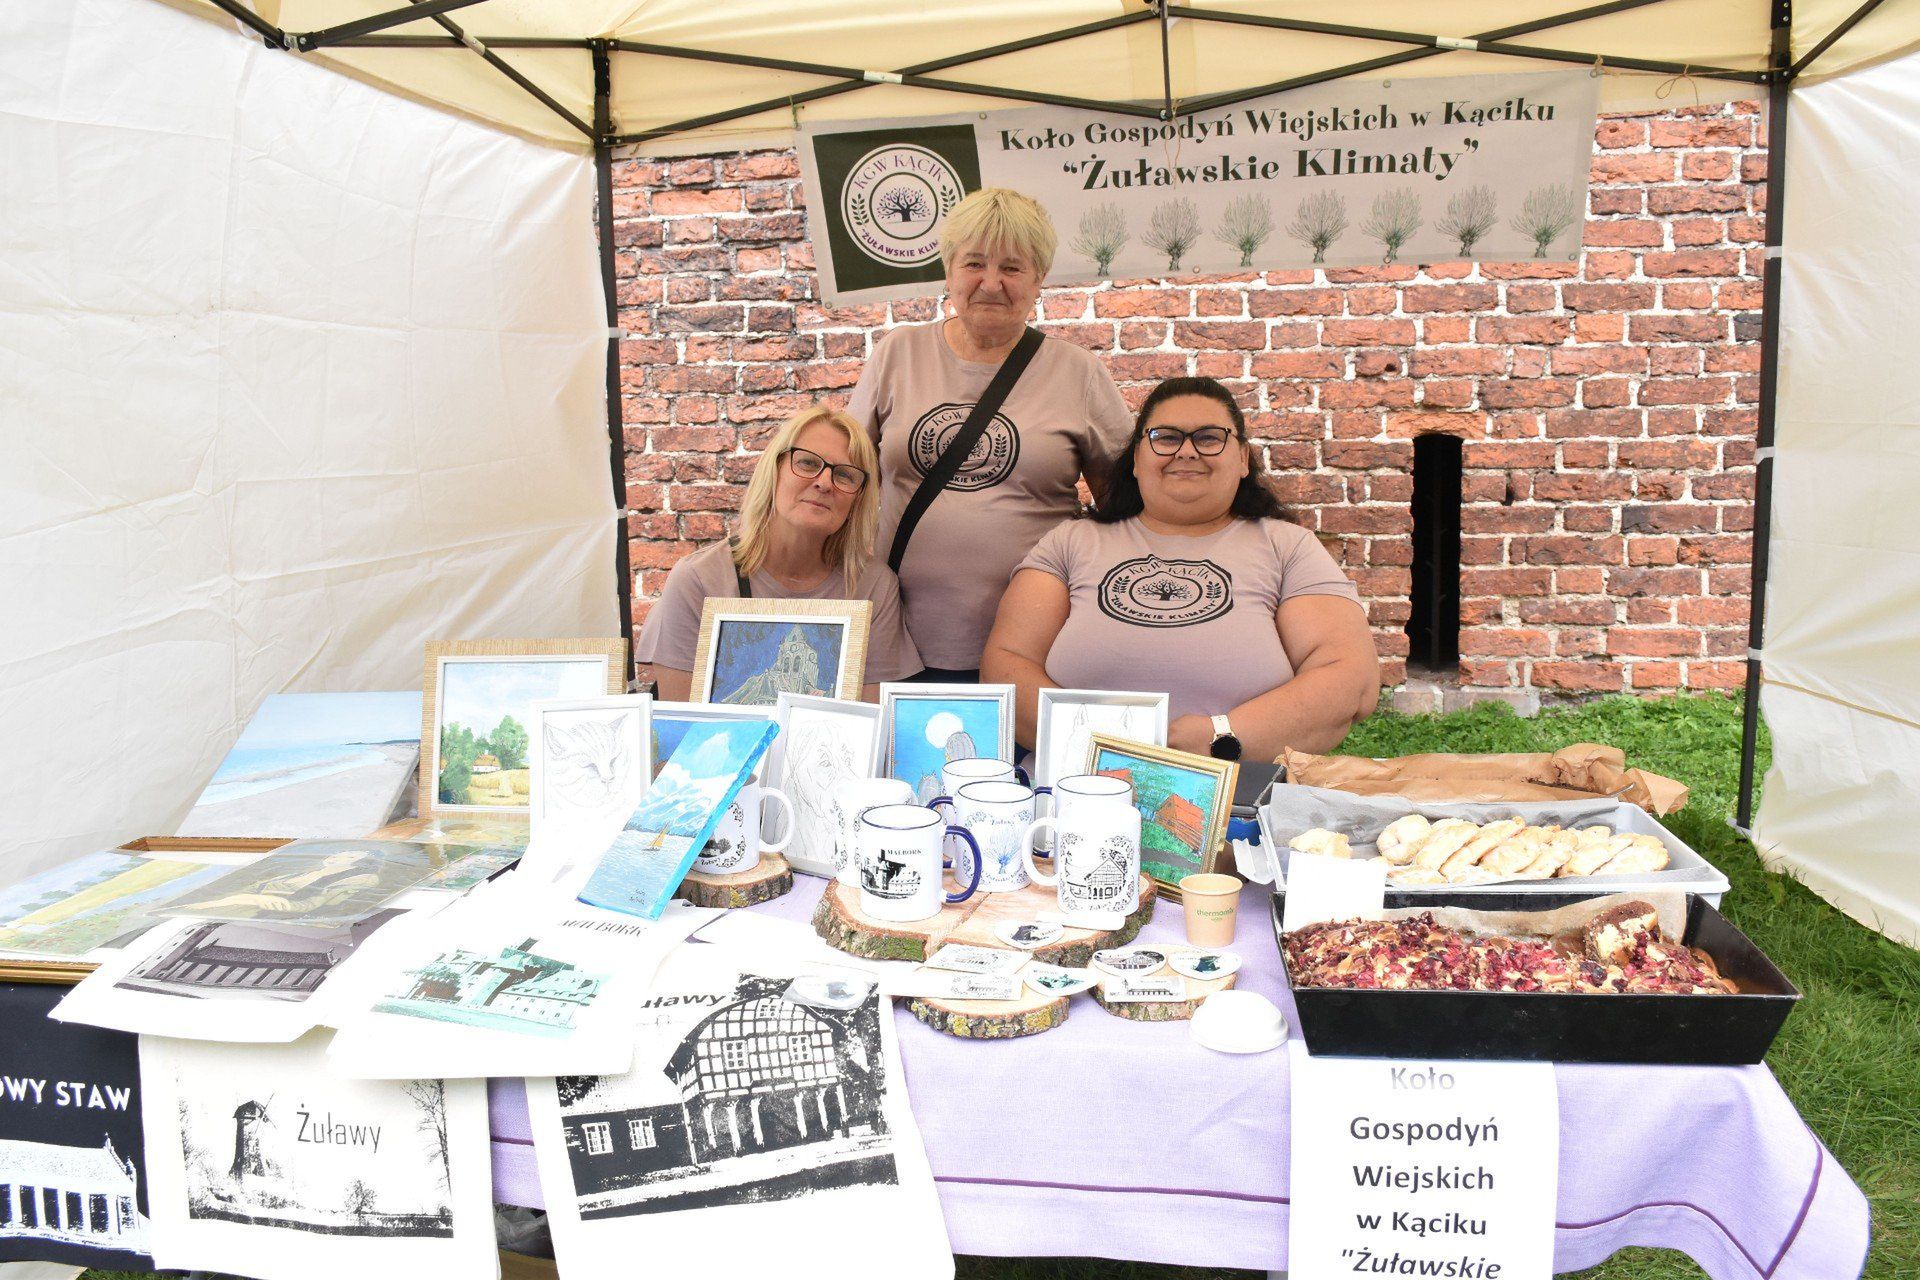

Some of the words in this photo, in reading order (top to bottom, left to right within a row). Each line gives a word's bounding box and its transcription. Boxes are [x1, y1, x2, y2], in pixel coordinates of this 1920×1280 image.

[997, 128, 1075, 151] Koło
[1084, 113, 1234, 147] Gospodyń
[1242, 104, 1398, 141] Wiejskich
[1408, 111, 1431, 127] w
[1440, 97, 1555, 127] Kąciku
[854, 158, 887, 189] KGW
[894, 154, 947, 182] KĄCIK
[1063, 154, 1280, 190] “Żuławskie
[1292, 138, 1479, 181] Klimaty”
[932, 409, 964, 427] KGW
[0, 1075, 46, 1104] WY
[55, 1080, 131, 1111] STAW
[1390, 1066, 1456, 1090] Koło
[296, 1103, 381, 1153] Żuławy
[1350, 1116, 1499, 1146] Gospodyń
[1352, 1165, 1494, 1193] Wiejskich
[1356, 1214, 1382, 1230] w
[1392, 1211, 1487, 1237] Kąciku
